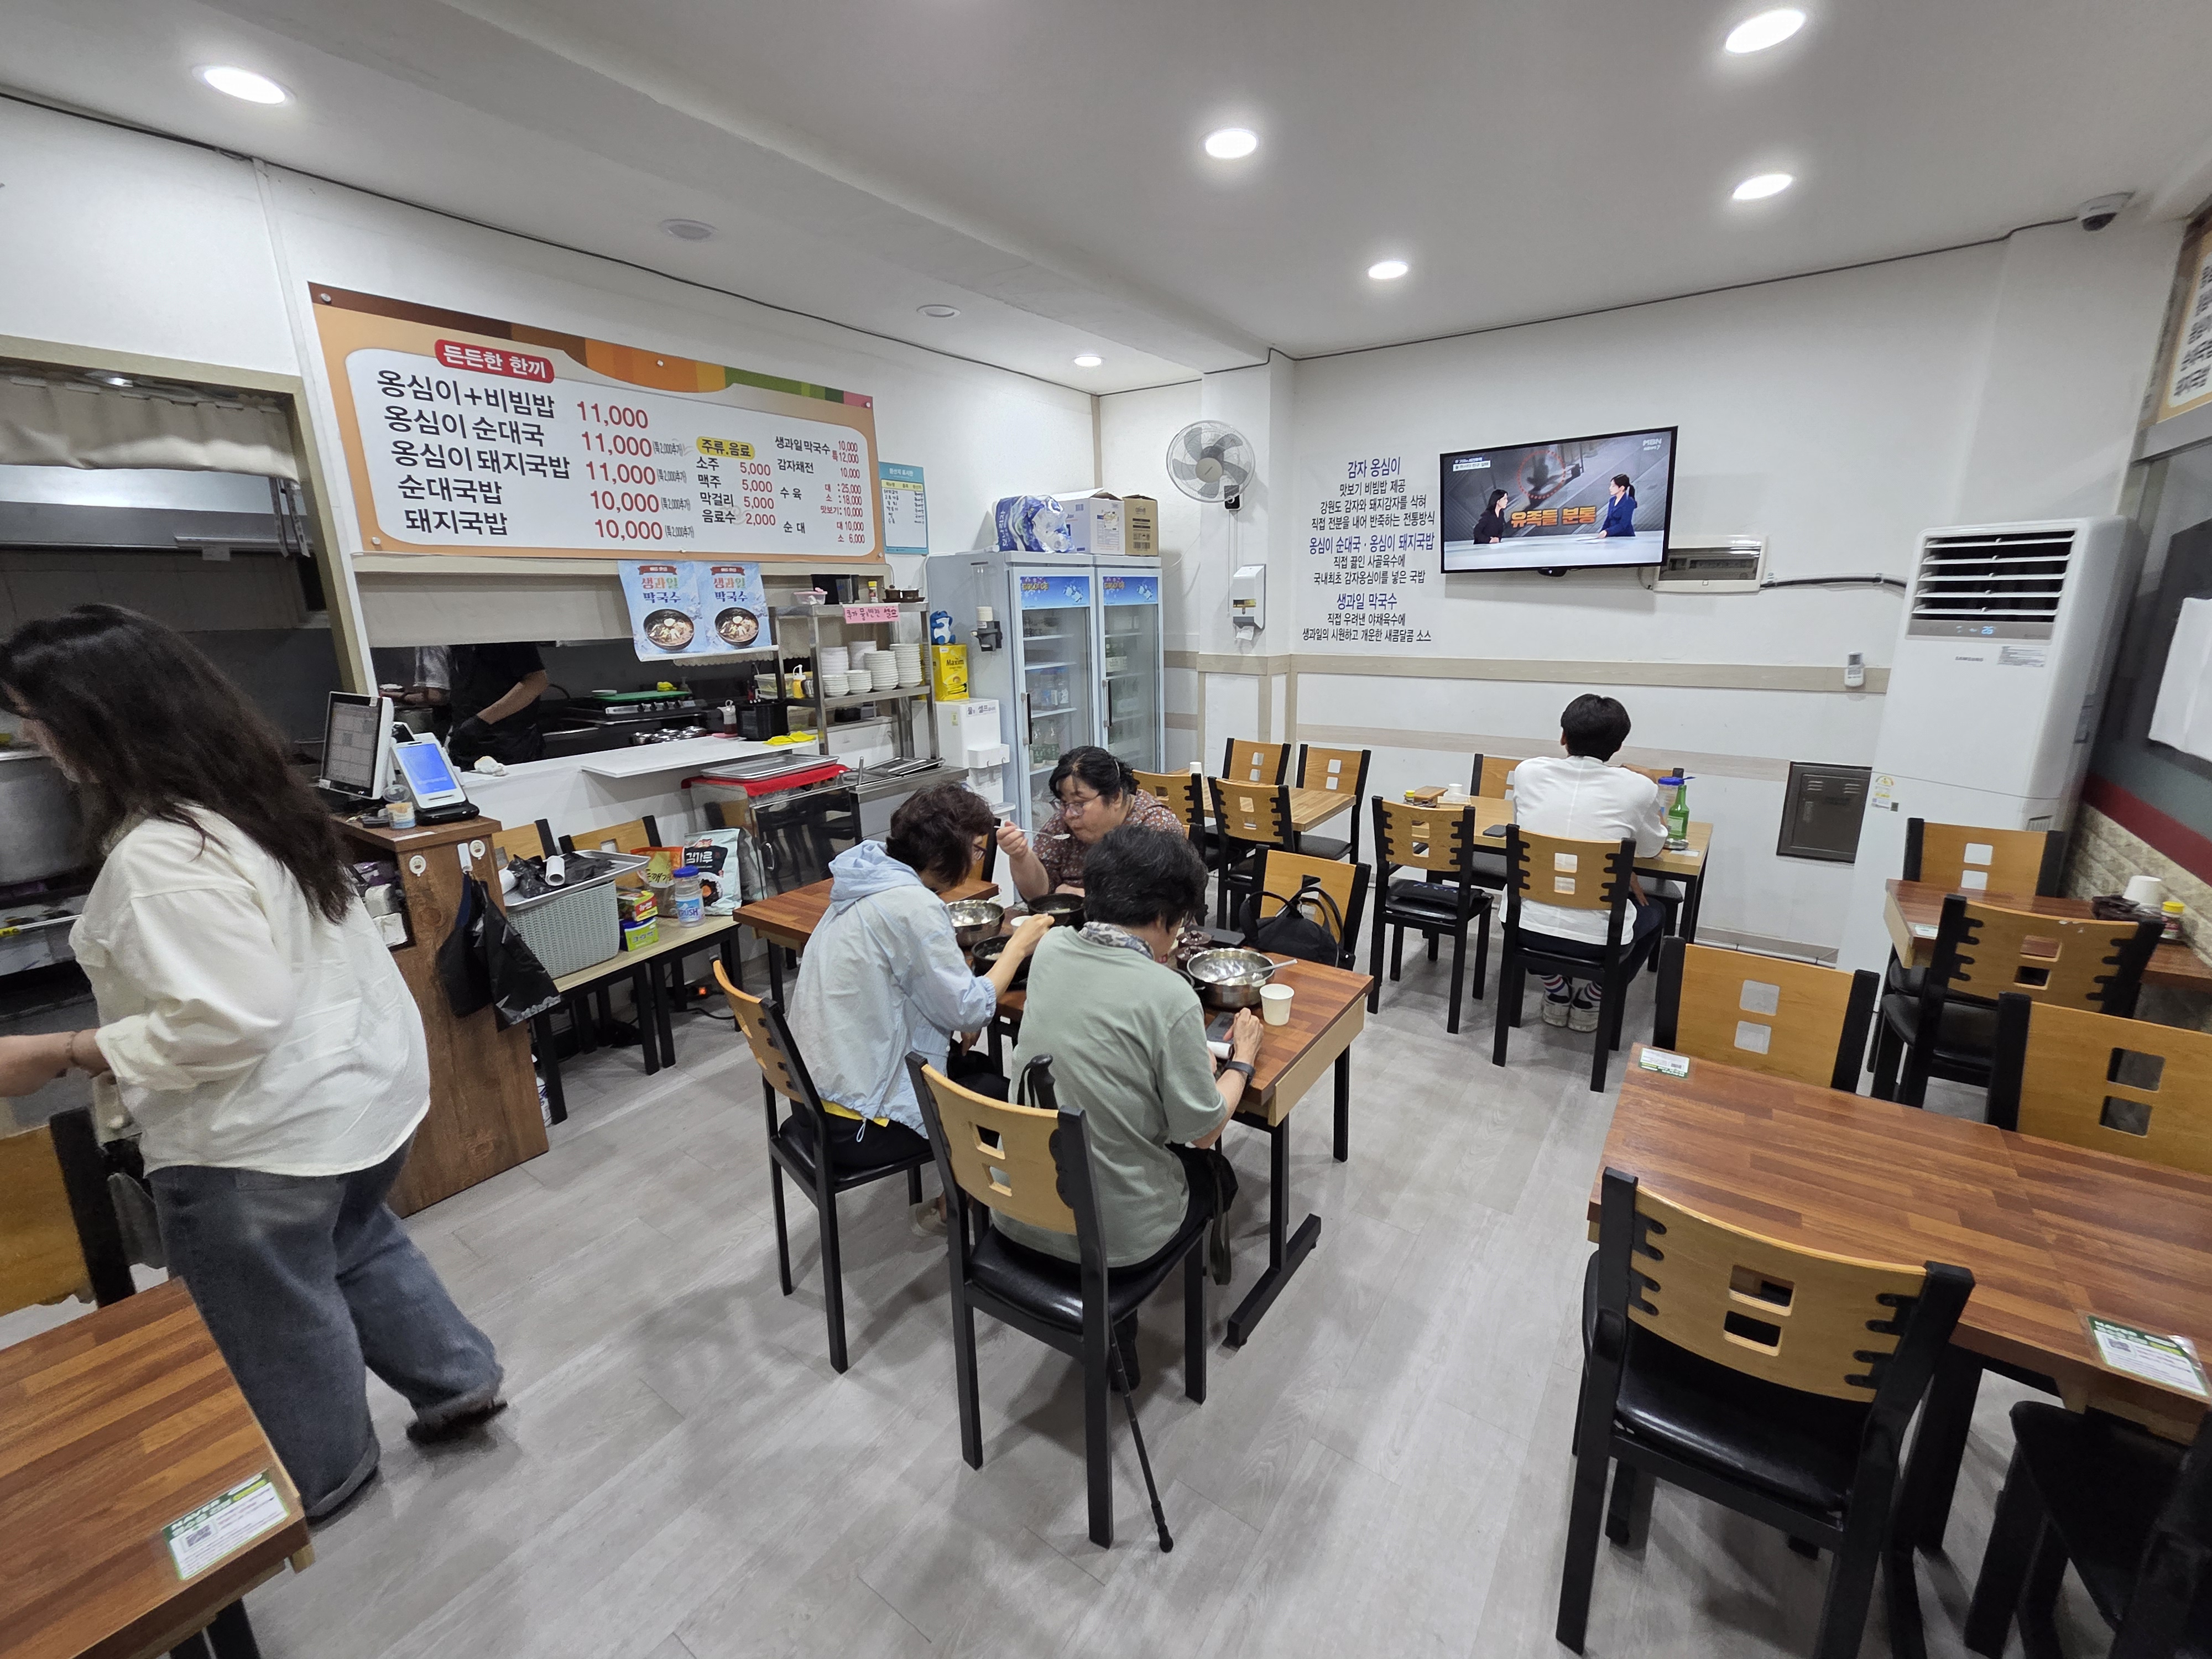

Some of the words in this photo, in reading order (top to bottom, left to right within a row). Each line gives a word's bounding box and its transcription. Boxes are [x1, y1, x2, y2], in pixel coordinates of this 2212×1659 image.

[443, 345, 503, 372] 든든한
[510, 357, 546, 379] 한끼
[377, 370, 555, 419] 옹심이+비빔밥
[577, 400, 648, 429] 11,000
[384, 405, 466, 440] 옹심이
[472, 416, 544, 447] 순대국
[582, 431, 652, 457] 11,000
[839, 441, 858, 452] 10,000
[391, 440, 473, 472] 옹심이
[478, 448, 570, 480] 돼지국밥
[586, 461, 655, 486] 11,000
[696, 457, 719, 471] 소주
[740, 462, 771, 476] 5,000
[777, 458, 813, 474] 감자채전
[841, 467, 860, 478] 10,000
[1348, 460, 1366, 479] 감자
[1370, 457, 1400, 477] 옹심이
[698, 473, 721, 489] 맥주
[742, 479, 773, 493] 5,000
[825, 484, 831, 492] 대
[1340, 482, 1362, 497] 맛보기
[1365, 481, 1387, 495] 비빔밥
[1390, 479, 1406, 493] 제공
[398, 474, 502, 505] 순대국밥
[590, 490, 659, 513] 10,000
[700, 492, 734, 508] 막걸리
[744, 497, 774, 510] 5,000
[1321, 500, 1342, 514] 강원도
[1344, 498, 1366, 513] 감자와
[1369, 496, 1407, 512] 돼지감자를
[404, 508, 508, 535] 돼지국밥
[594, 519, 662, 541] 10,000
[702, 509, 735, 524] 음료수
[745, 513, 776, 526] 2,000
[845, 521, 864, 531] 10,000
[1312, 518, 1325, 530] 직접
[1328, 516, 1349, 530] 전분을
[1353, 515, 1367, 529] 내어
[1370, 513, 1400, 528] 반죽하는
[1404, 510, 1435, 526] 전통방식
[1511, 509, 1557, 528] 유족들
[1562, 506, 1596, 525] 분통
[838, 534, 844, 542] 소
[849, 534, 865, 544] 6,000
[1310, 537, 1333, 555] 옹심이
[1336, 536, 1360, 553] 순대국
[1370, 534, 1395, 552] 옹심이
[1399, 532, 1434, 551] 돼지국밥
[1334, 556, 1348, 569] 직접
[1368, 554, 1405, 568] 사골육수에
[641, 577, 679, 589] 생과일
[713, 577, 747, 589] 생과일
[1313, 572, 1342, 585] 국내최초
[1344, 571, 1389, 585] 감자옹심이를
[1392, 571, 1406, 584] 넣은
[1410, 570, 1425, 583] 국밥
[643, 592, 681, 603] 막국수
[714, 591, 748, 602] 막국수
[1337, 593, 1365, 610] 생과일
[1369, 593, 1397, 610] 막국수
[1327, 613, 1341, 626] 직접
[1344, 613, 1365, 626] 우려낸
[1368, 613, 1405, 627] 야채육수에
[1302, 628, 1329, 640] 생과일의
[1331, 629, 1358, 641] 시원하고
[1361, 629, 1382, 642] 개운한
[1416, 630, 1431, 641] 소스
[686, 851, 713, 864] 김가루
